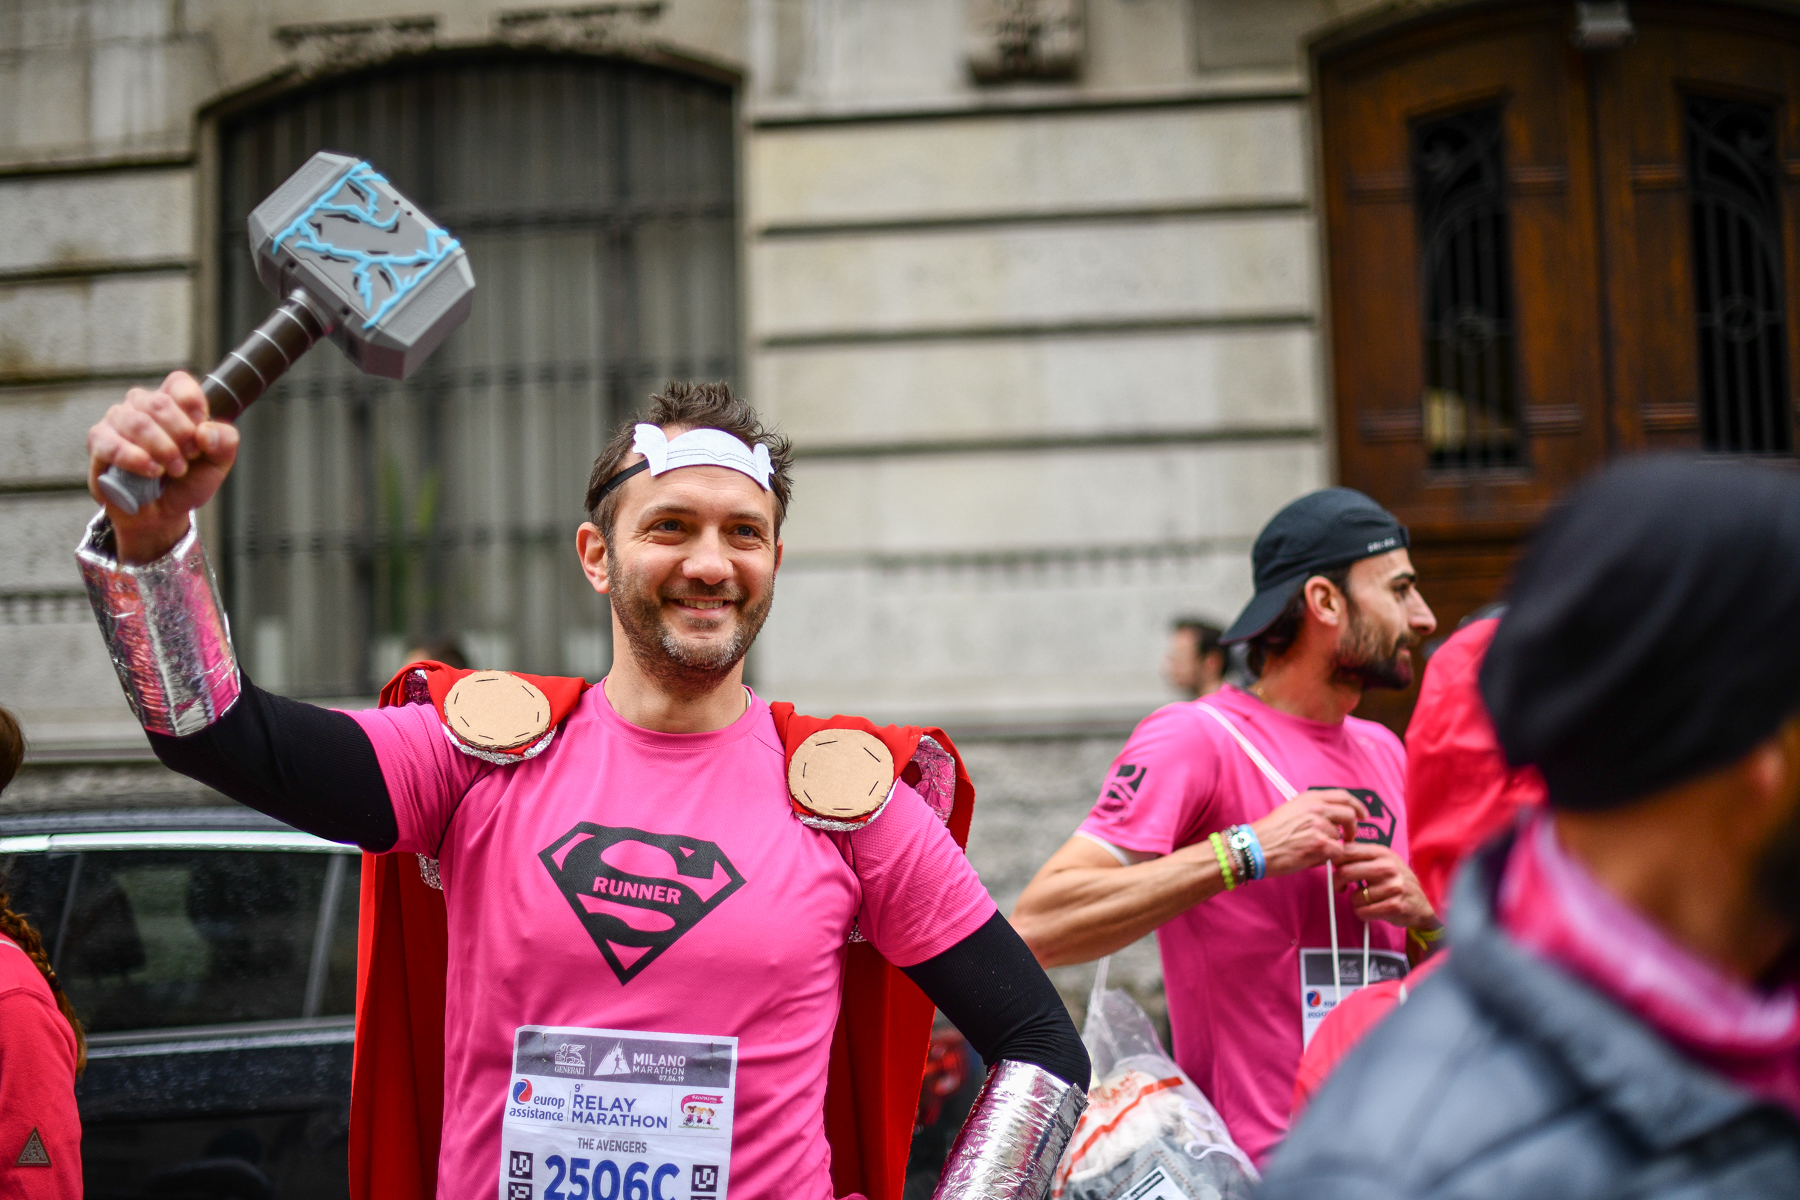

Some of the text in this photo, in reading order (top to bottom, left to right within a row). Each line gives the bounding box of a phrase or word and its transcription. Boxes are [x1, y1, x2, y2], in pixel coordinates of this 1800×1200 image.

[592, 876, 682, 905] RUNNER
[633, 1053, 686, 1067] MILANO
[554, 1065, 585, 1075] GENERALI
[632, 1065, 685, 1076] MARATHON
[659, 1075, 685, 1083] 07.04.19
[533, 1095, 566, 1110] europ
[573, 1094, 637, 1113] RELAY
[509, 1106, 564, 1122] assistance
[571, 1111, 668, 1129] MARATHON
[577, 1137, 648, 1154] THE AVENGERS
[543, 1154, 681, 1200] 2506C
